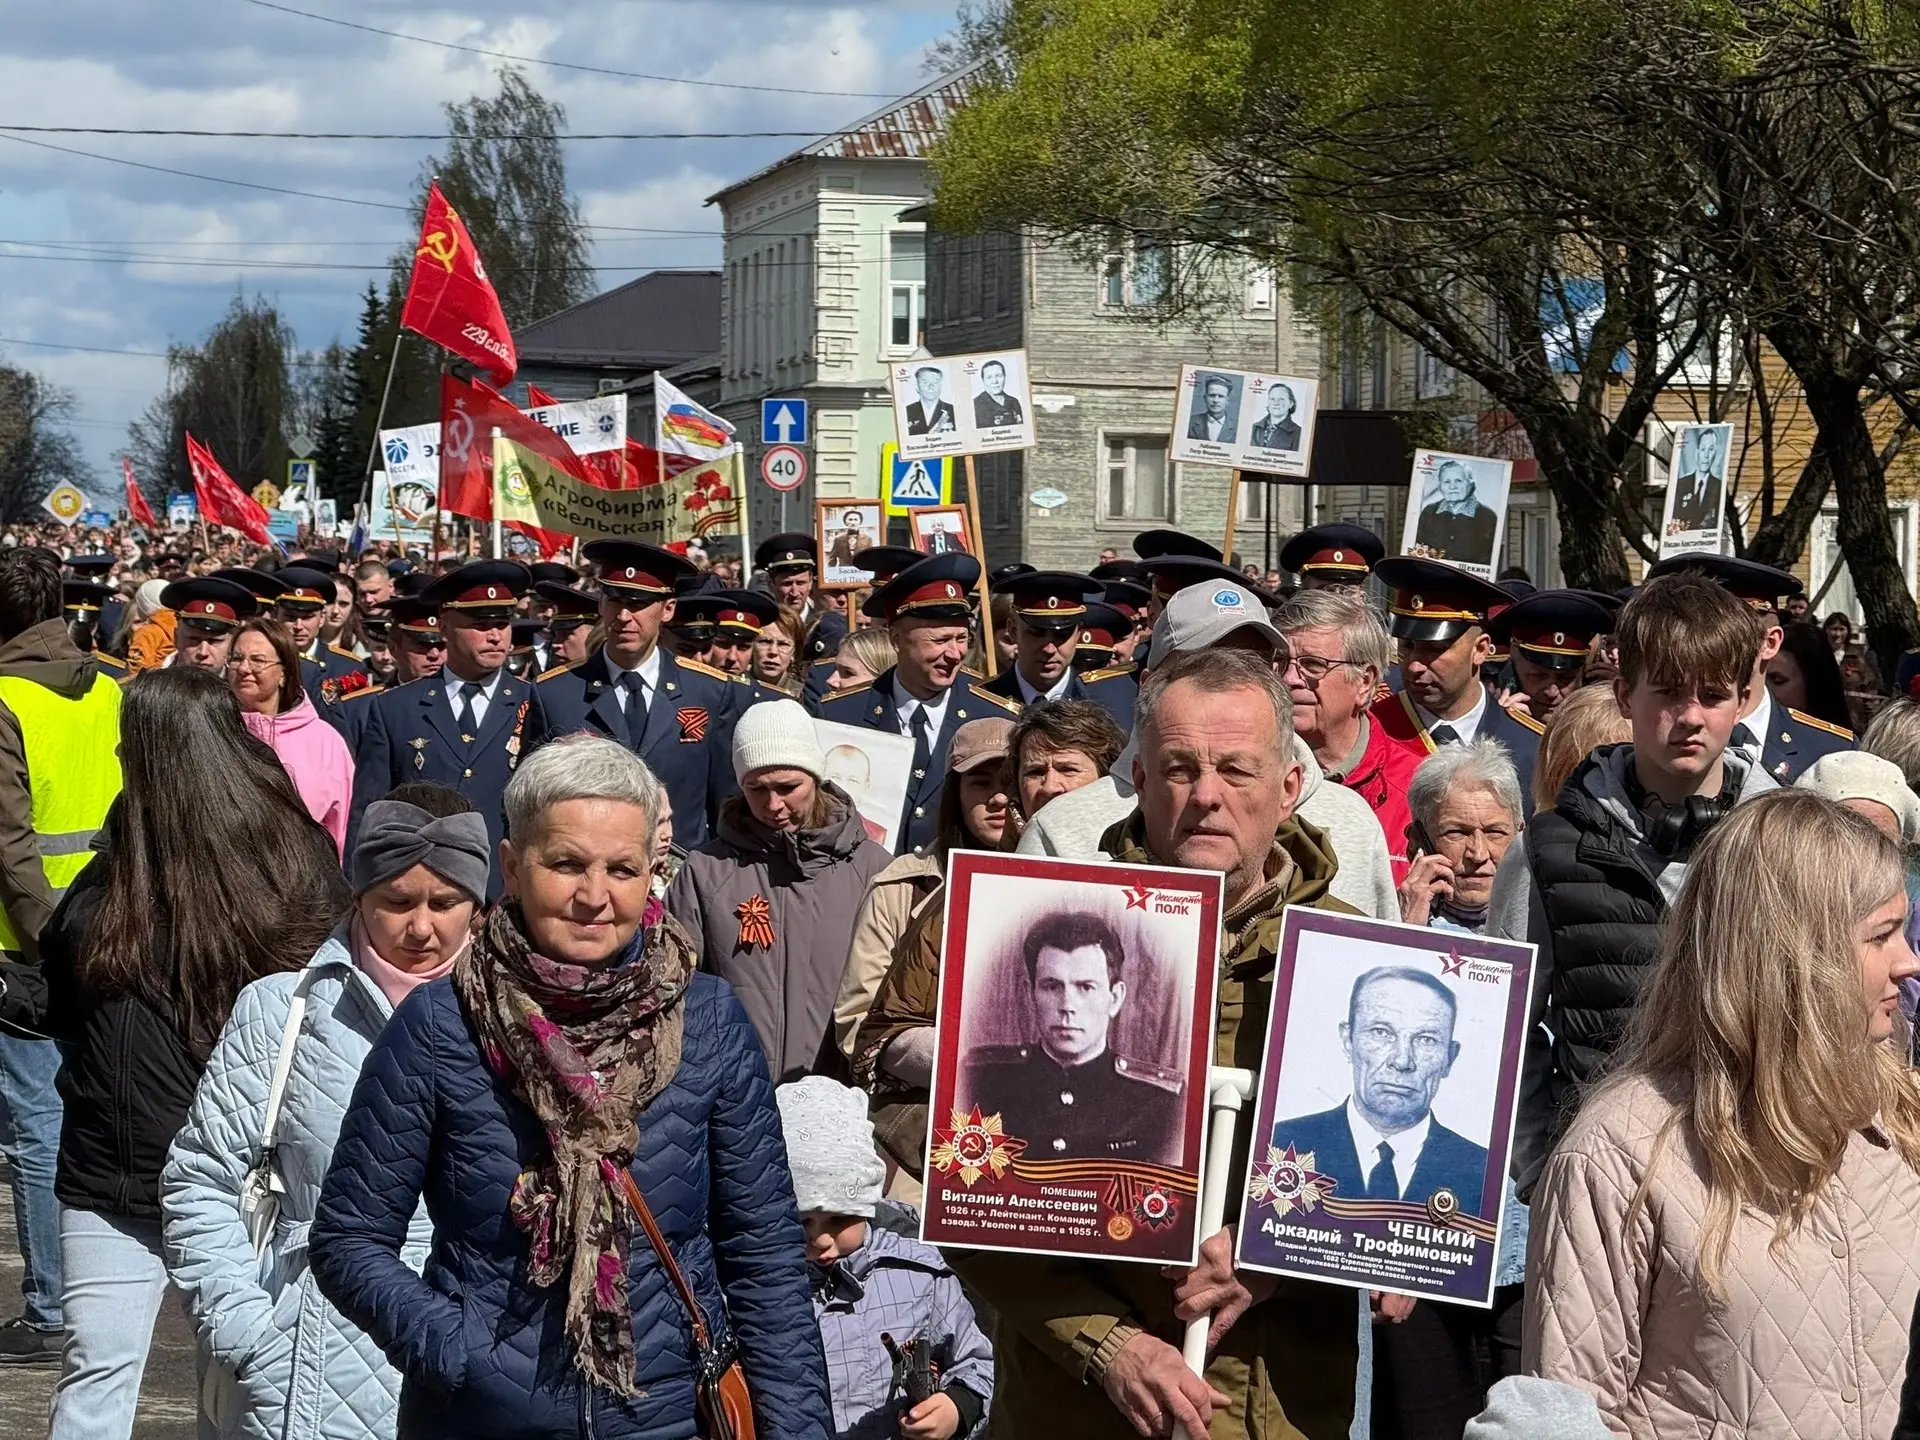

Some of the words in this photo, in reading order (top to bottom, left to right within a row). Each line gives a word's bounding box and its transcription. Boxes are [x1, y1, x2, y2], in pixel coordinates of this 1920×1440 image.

[461, 323, 489, 345] 229
[771, 459, 796, 476] 40
[544, 474, 677, 518] Агрофирма
[543, 495, 677, 535] «Вельская»
[1155, 904, 1189, 916] ПОЛК
[1468, 971, 1500, 984] ПОЛК
[941, 1189, 1004, 1206] Виталий
[1008, 1194, 1098, 1213] Алексеевич
[1040, 1186, 1097, 1199] ПОМЕШКИН
[945, 1206, 968, 1215] 1926
[970, 1209, 987, 1218] г.р.
[989, 1209, 1044, 1222] Лейтенант.
[1047, 1214, 1097, 1226] Командир
[941, 1218, 978, 1228] взвода.
[980, 1220, 1017, 1230] Уволен
[1028, 1225, 1056, 1234] запас
[1068, 1227, 1092, 1236] 1955
[1387, 1221, 1476, 1249] ЧЕЦКИЙ
[1260, 1218, 1342, 1245] Аркадий
[1352, 1232, 1474, 1266] Трофимович
[1274, 1240, 1308, 1252] Младший
[1348, 1252, 1383, 1264] Командир
[1284, 1254, 1298, 1262] 310
[1322, 1254, 1340, 1262] 1082
